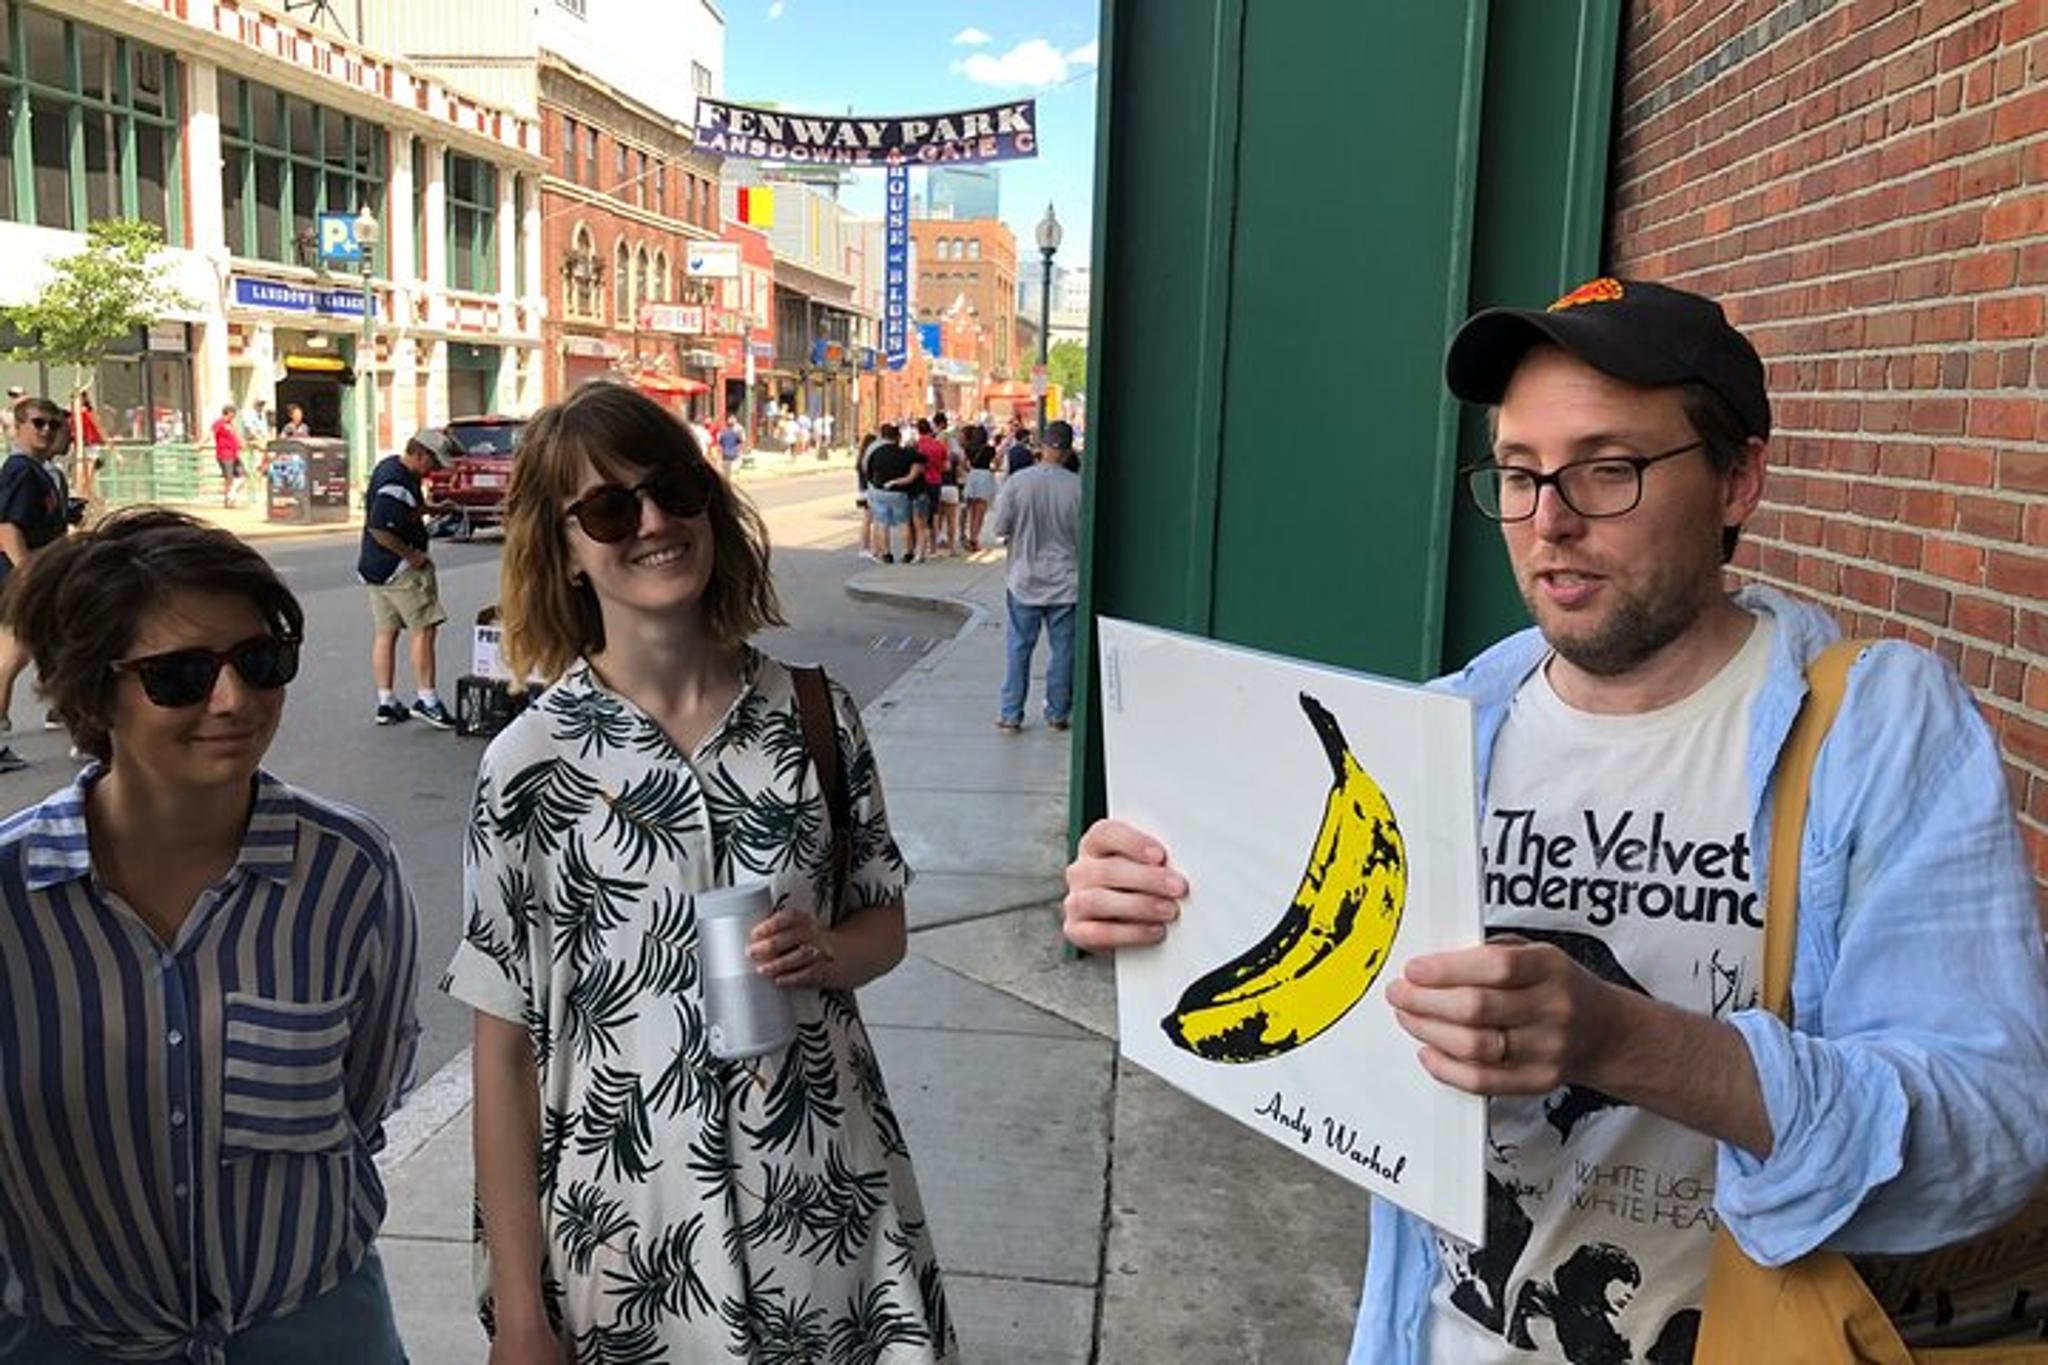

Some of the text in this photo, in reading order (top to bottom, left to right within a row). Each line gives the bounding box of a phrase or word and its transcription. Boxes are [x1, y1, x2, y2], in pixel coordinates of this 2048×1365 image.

[697, 101, 1031, 146] FENWAY PARK
[694, 128, 871, 163] LANSDOWNE
[918, 136, 998, 162] GATE
[1014, 133, 1033, 151] C
[321, 218, 348, 254] P
[1493, 809, 1750, 881] The Velvet
[1482, 845, 1764, 927] ndergroun
[1254, 1092, 1406, 1183] Andy Warhol
[1575, 1160, 1646, 1194] WHITE
[1572, 1192, 1644, 1223] WHITE
